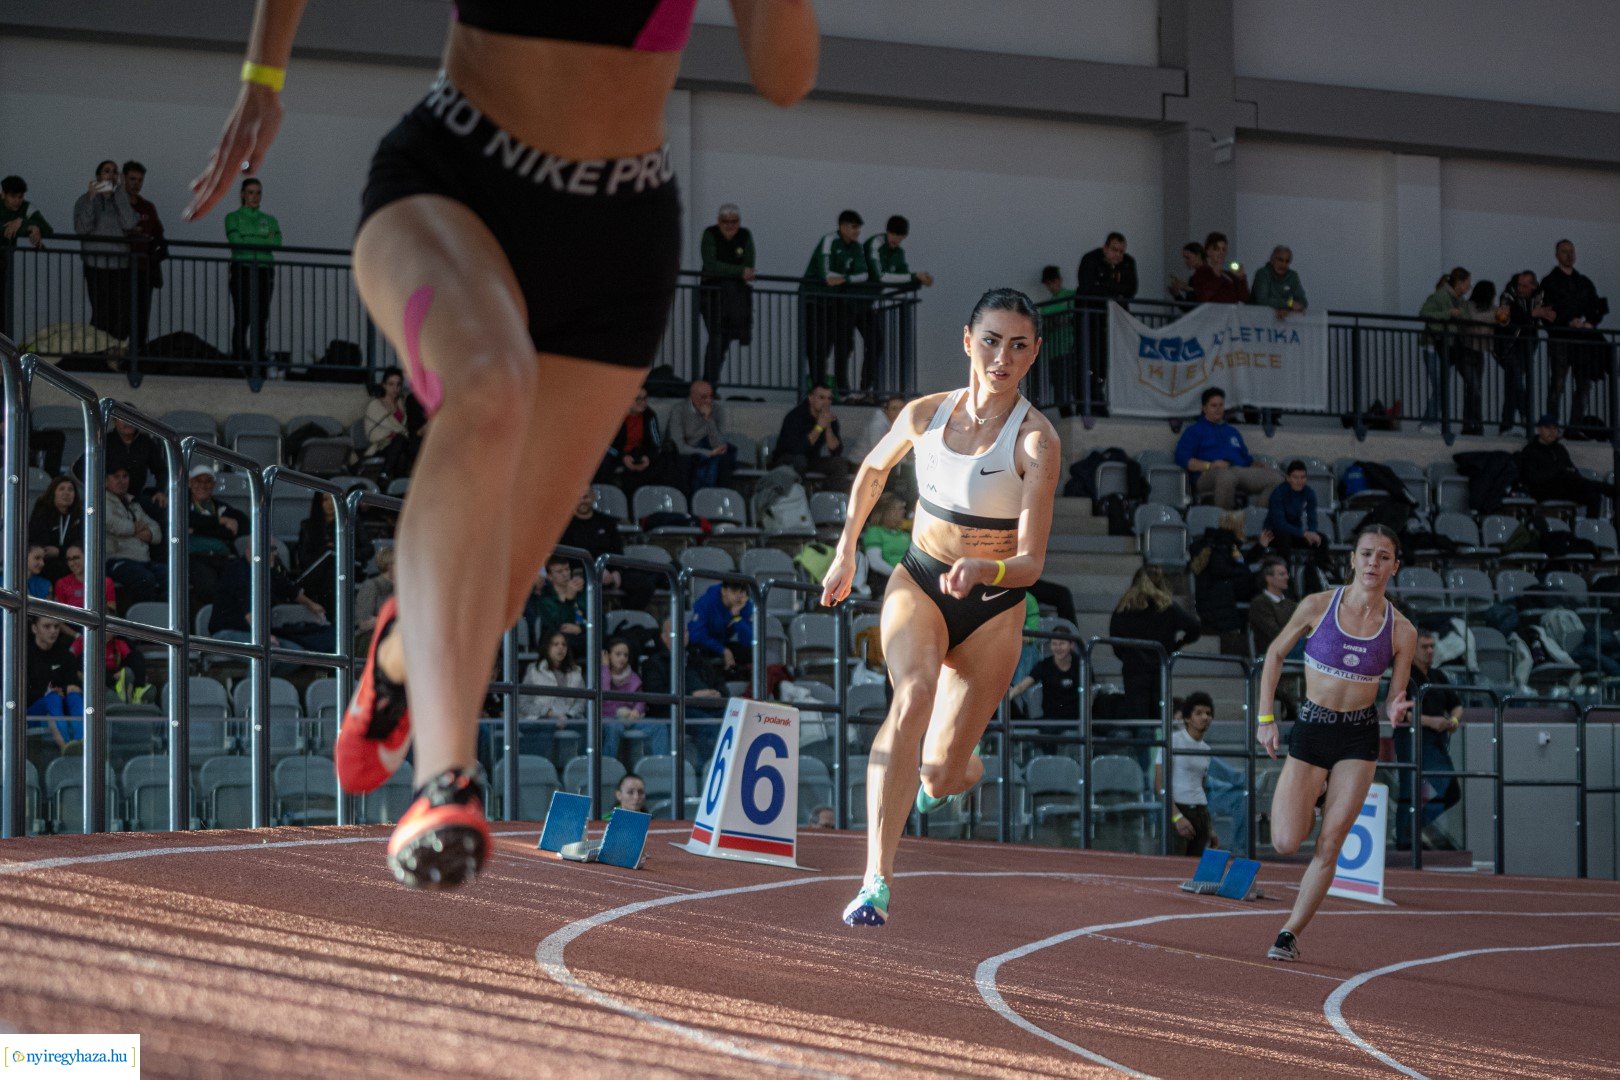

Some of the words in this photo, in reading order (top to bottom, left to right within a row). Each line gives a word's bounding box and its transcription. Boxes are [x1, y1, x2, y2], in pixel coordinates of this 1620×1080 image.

[483, 129, 607, 196] NIKE
[606, 144, 676, 195] PRO
[1316, 664, 1332, 674] UTE
[763, 716, 792, 727] polanik
[1309, 711, 1338, 724] PRO
[705, 725, 734, 816] 6
[741, 732, 789, 826] 6
